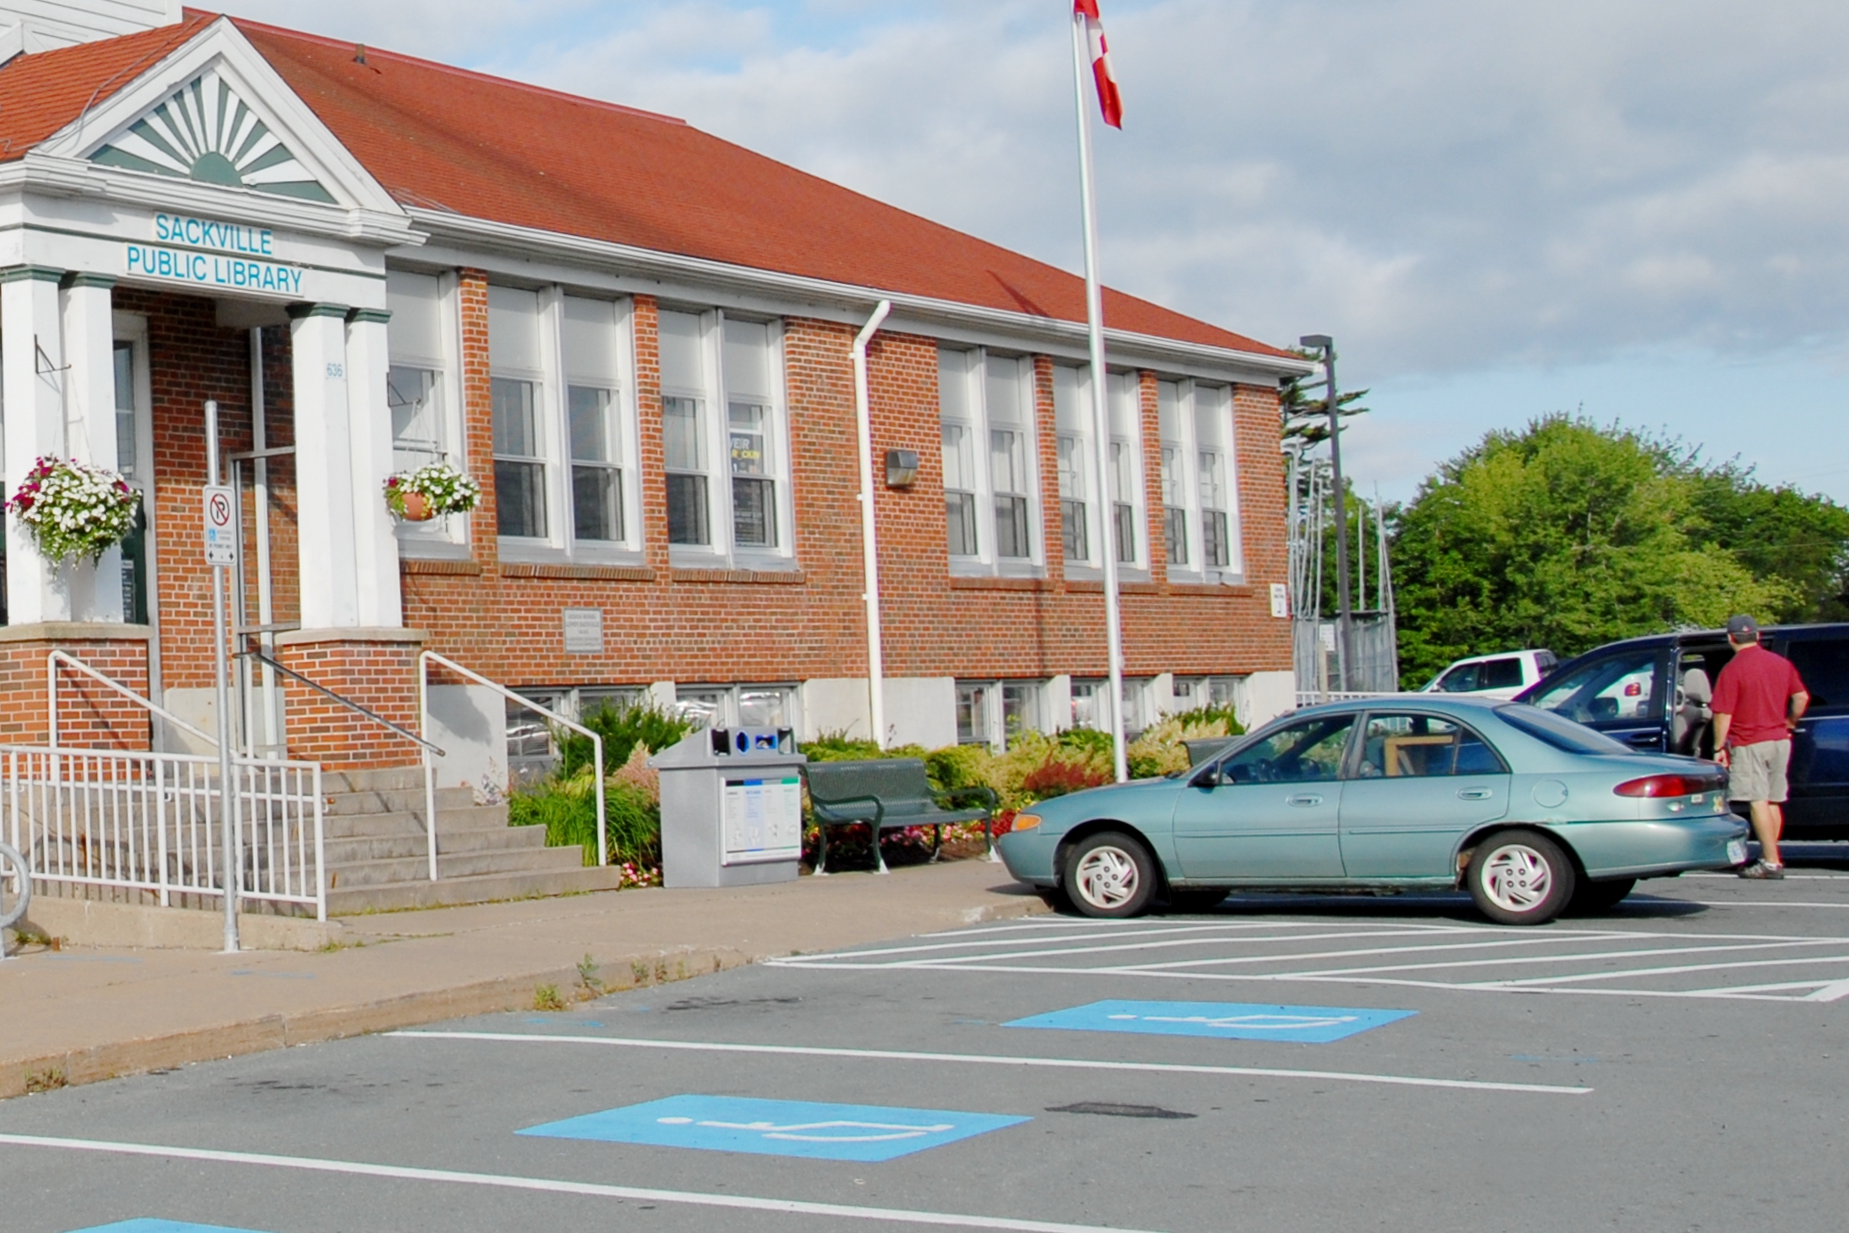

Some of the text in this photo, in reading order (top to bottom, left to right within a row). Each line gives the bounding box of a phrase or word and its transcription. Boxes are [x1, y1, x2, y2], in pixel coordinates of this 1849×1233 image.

[156, 214, 273, 255] SACKVILLE
[127, 246, 302, 293] PUBLIC LIBRARY
